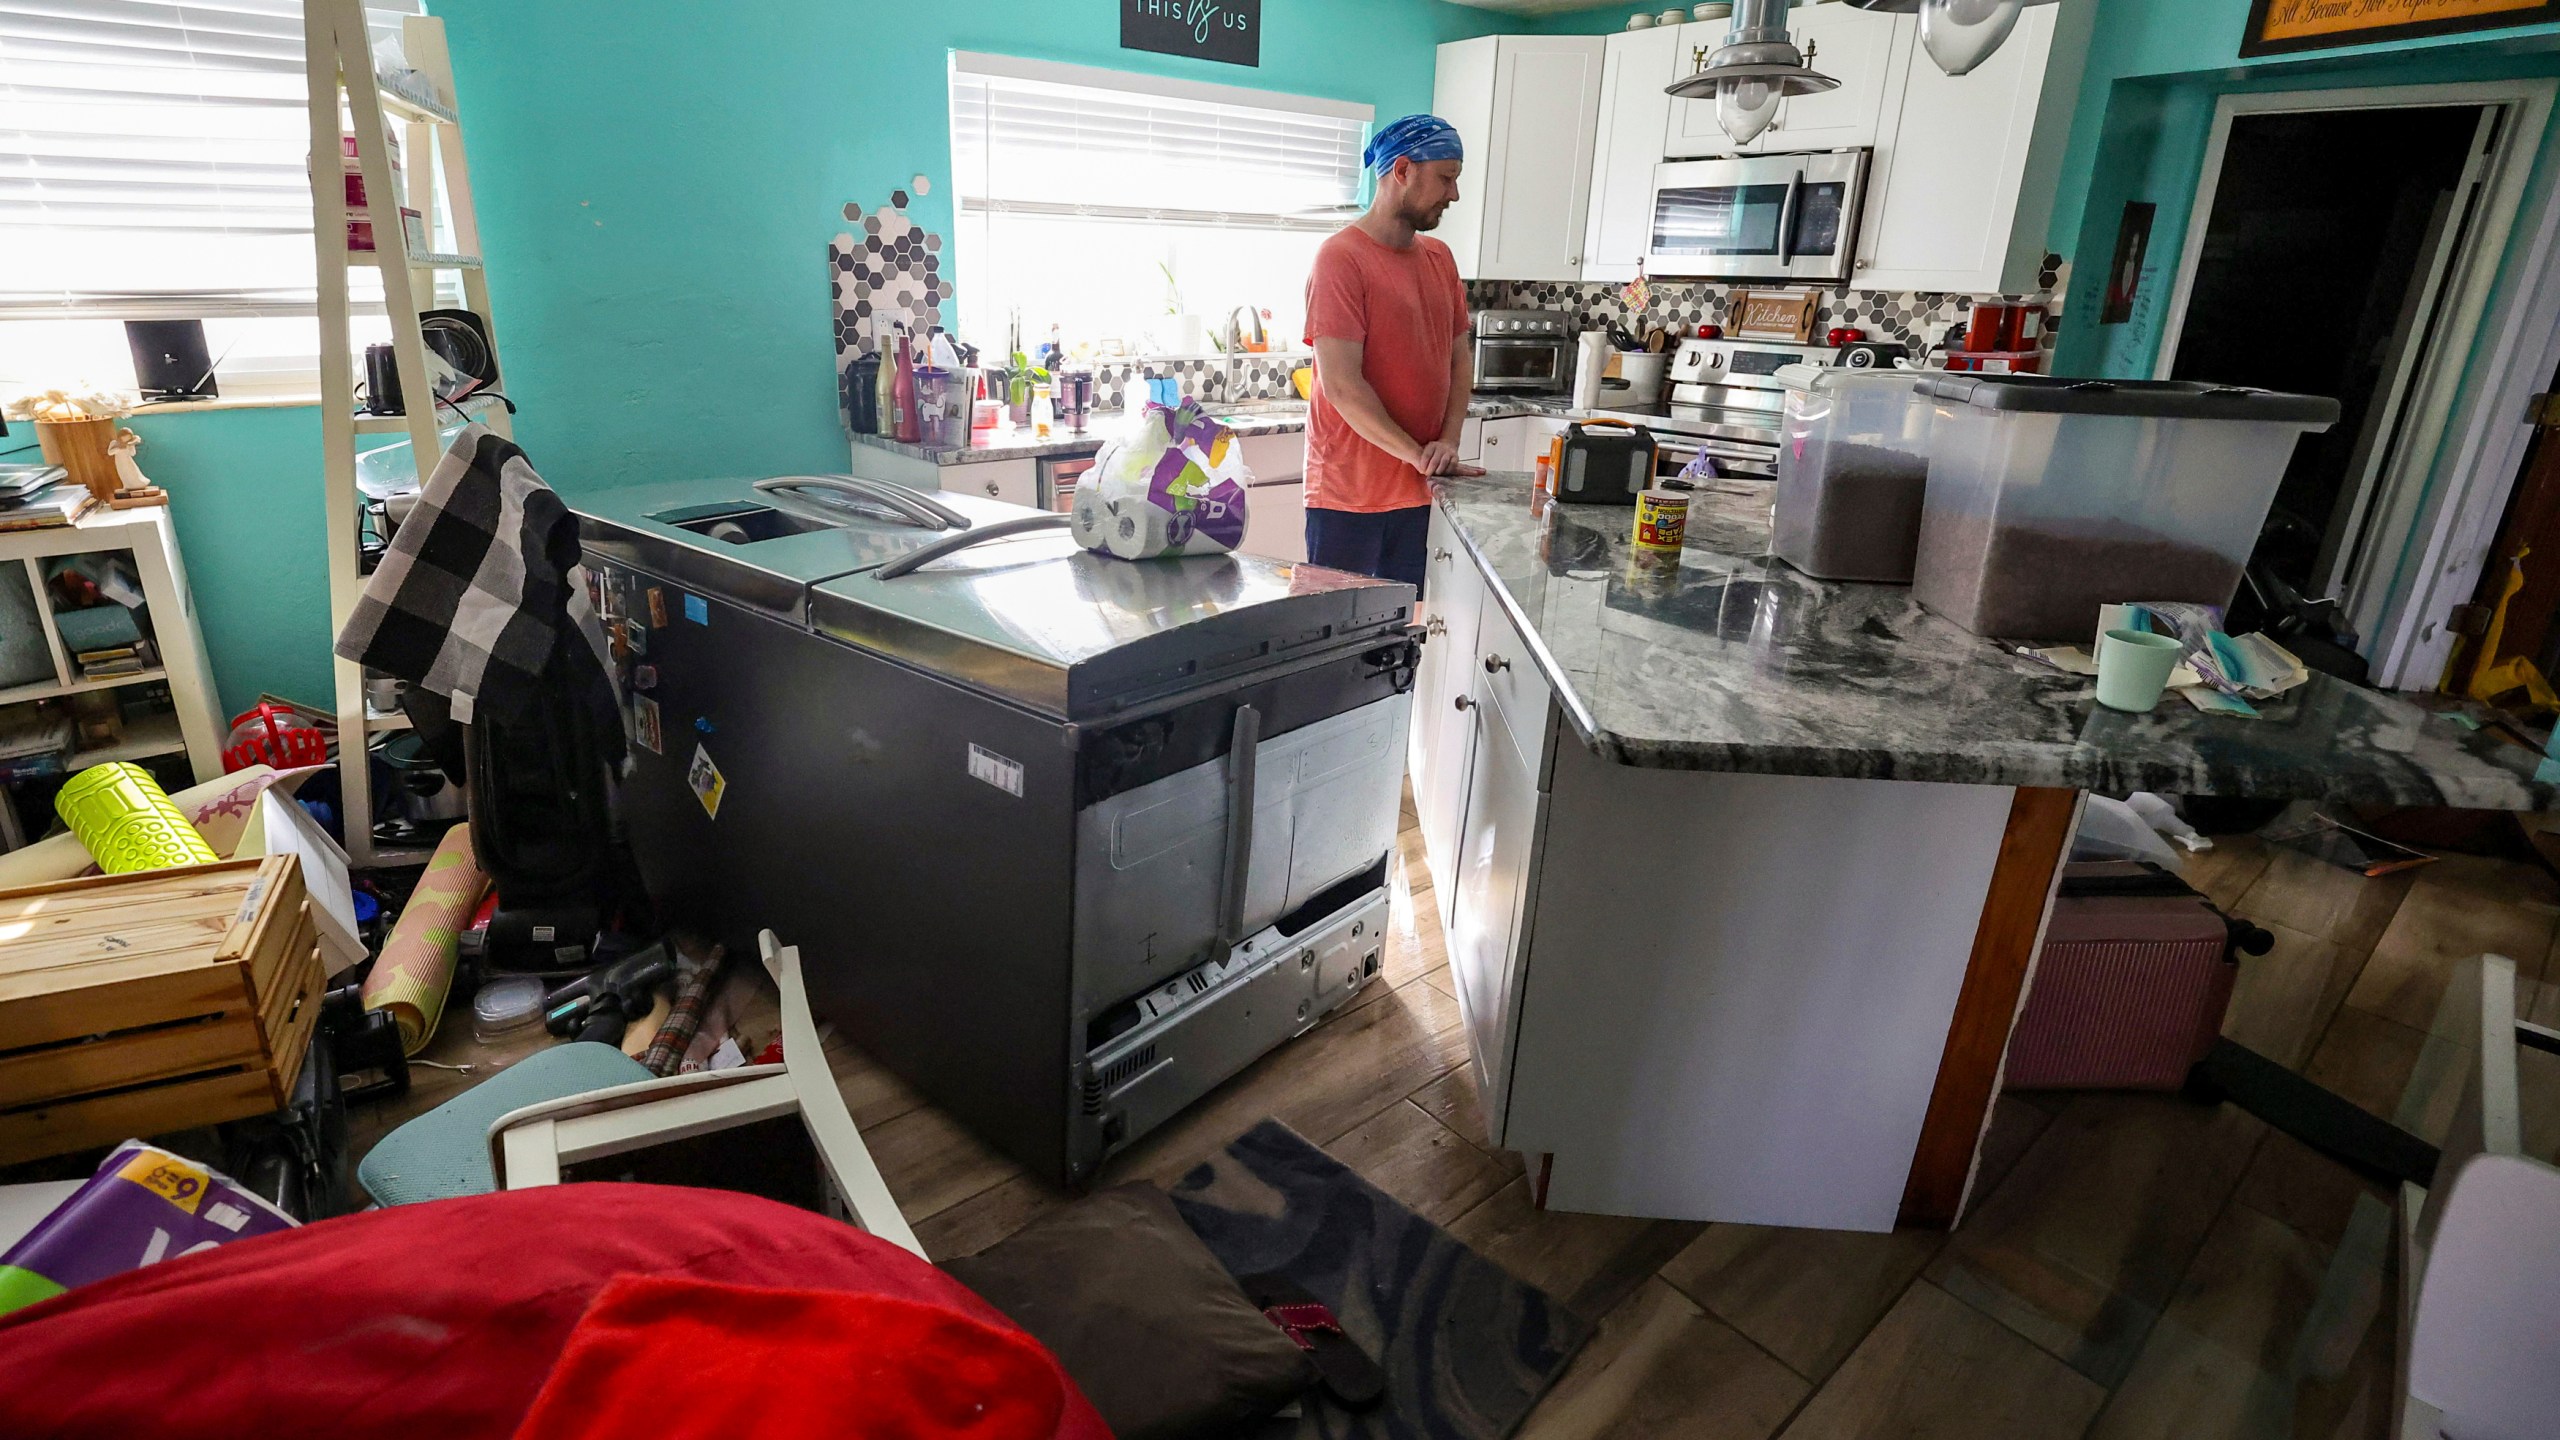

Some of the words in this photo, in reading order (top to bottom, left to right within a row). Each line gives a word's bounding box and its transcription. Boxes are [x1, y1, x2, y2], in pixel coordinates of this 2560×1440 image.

[1137, 0, 1182, 19] THIS
[1223, 11, 1247, 31] US
[2272, 1, 2300, 26] All
[2300, 0, 2353, 24] Because
[2354, 0, 2390, 18] Two
[1742, 302, 1798, 327] Kitchen
[1657, 534, 1682, 542] FLEX
[1658, 524, 1683, 536] TAPE
